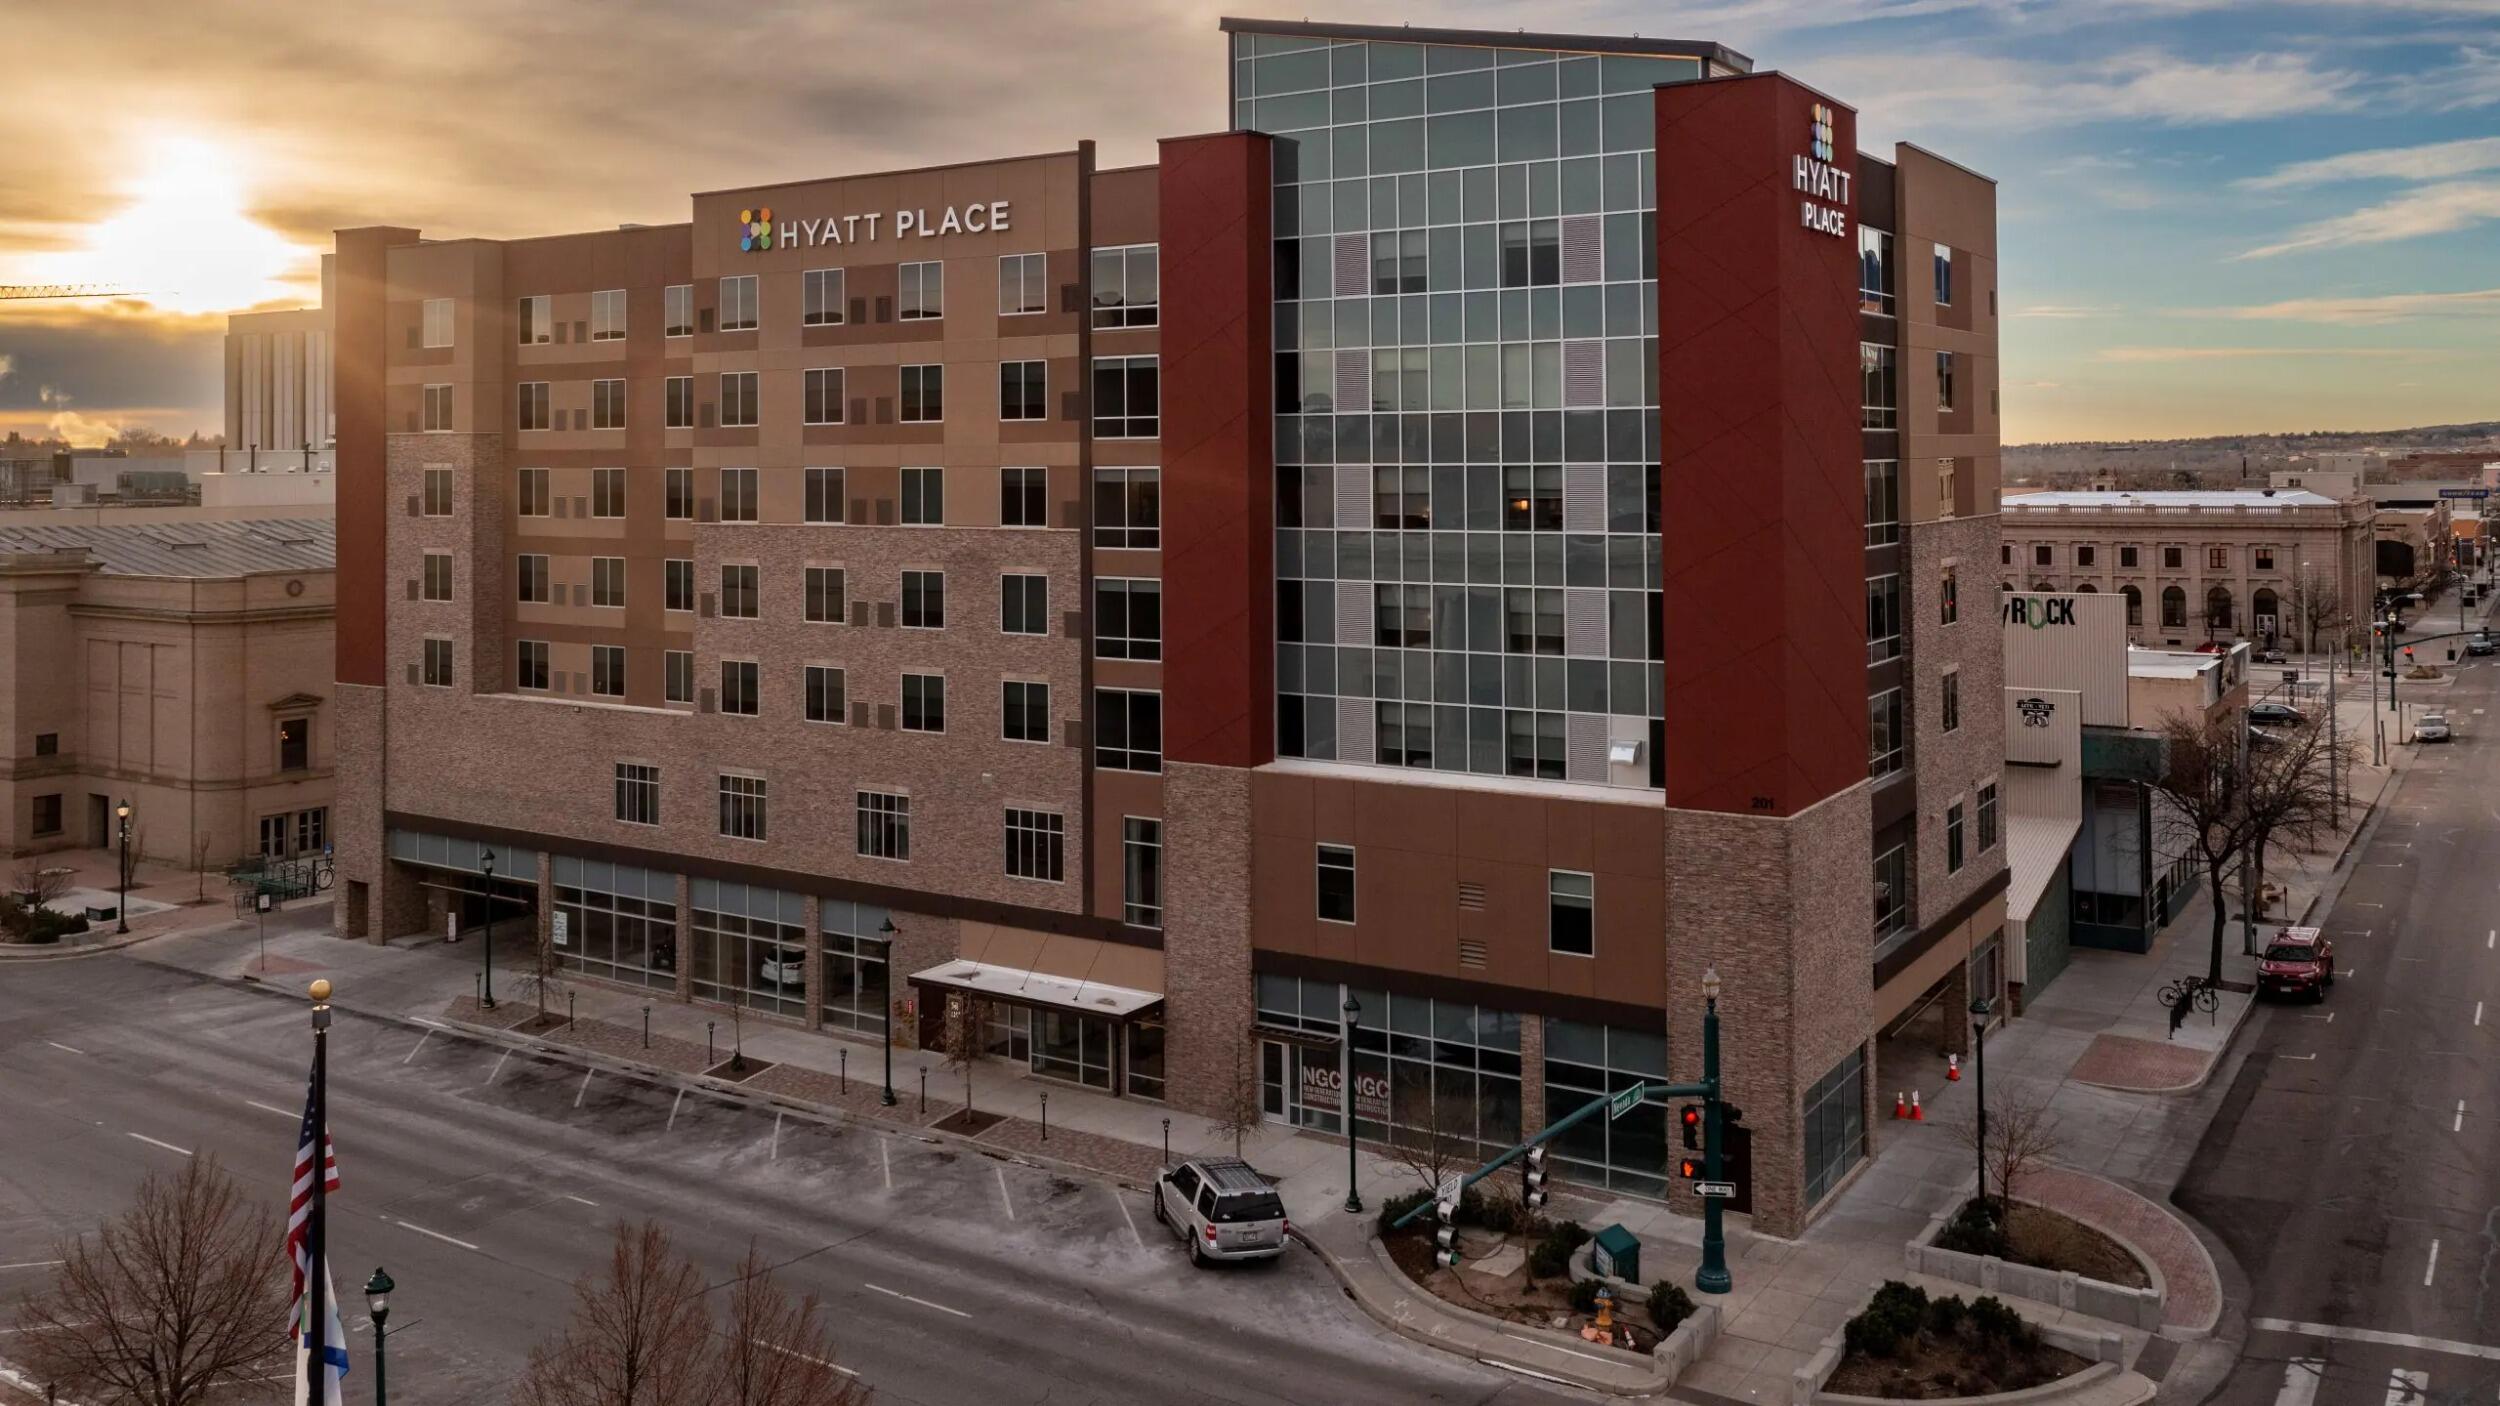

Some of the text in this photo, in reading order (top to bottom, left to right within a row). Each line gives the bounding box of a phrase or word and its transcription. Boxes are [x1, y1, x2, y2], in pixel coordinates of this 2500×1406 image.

[1793, 154, 1851, 205] HYATT
[780, 201, 1010, 249] HYATT PLACE
[1801, 201, 1845, 237] PLACE
[1303, 1065, 1341, 1089] NGC
[1441, 1179, 1458, 1197] YIELD
